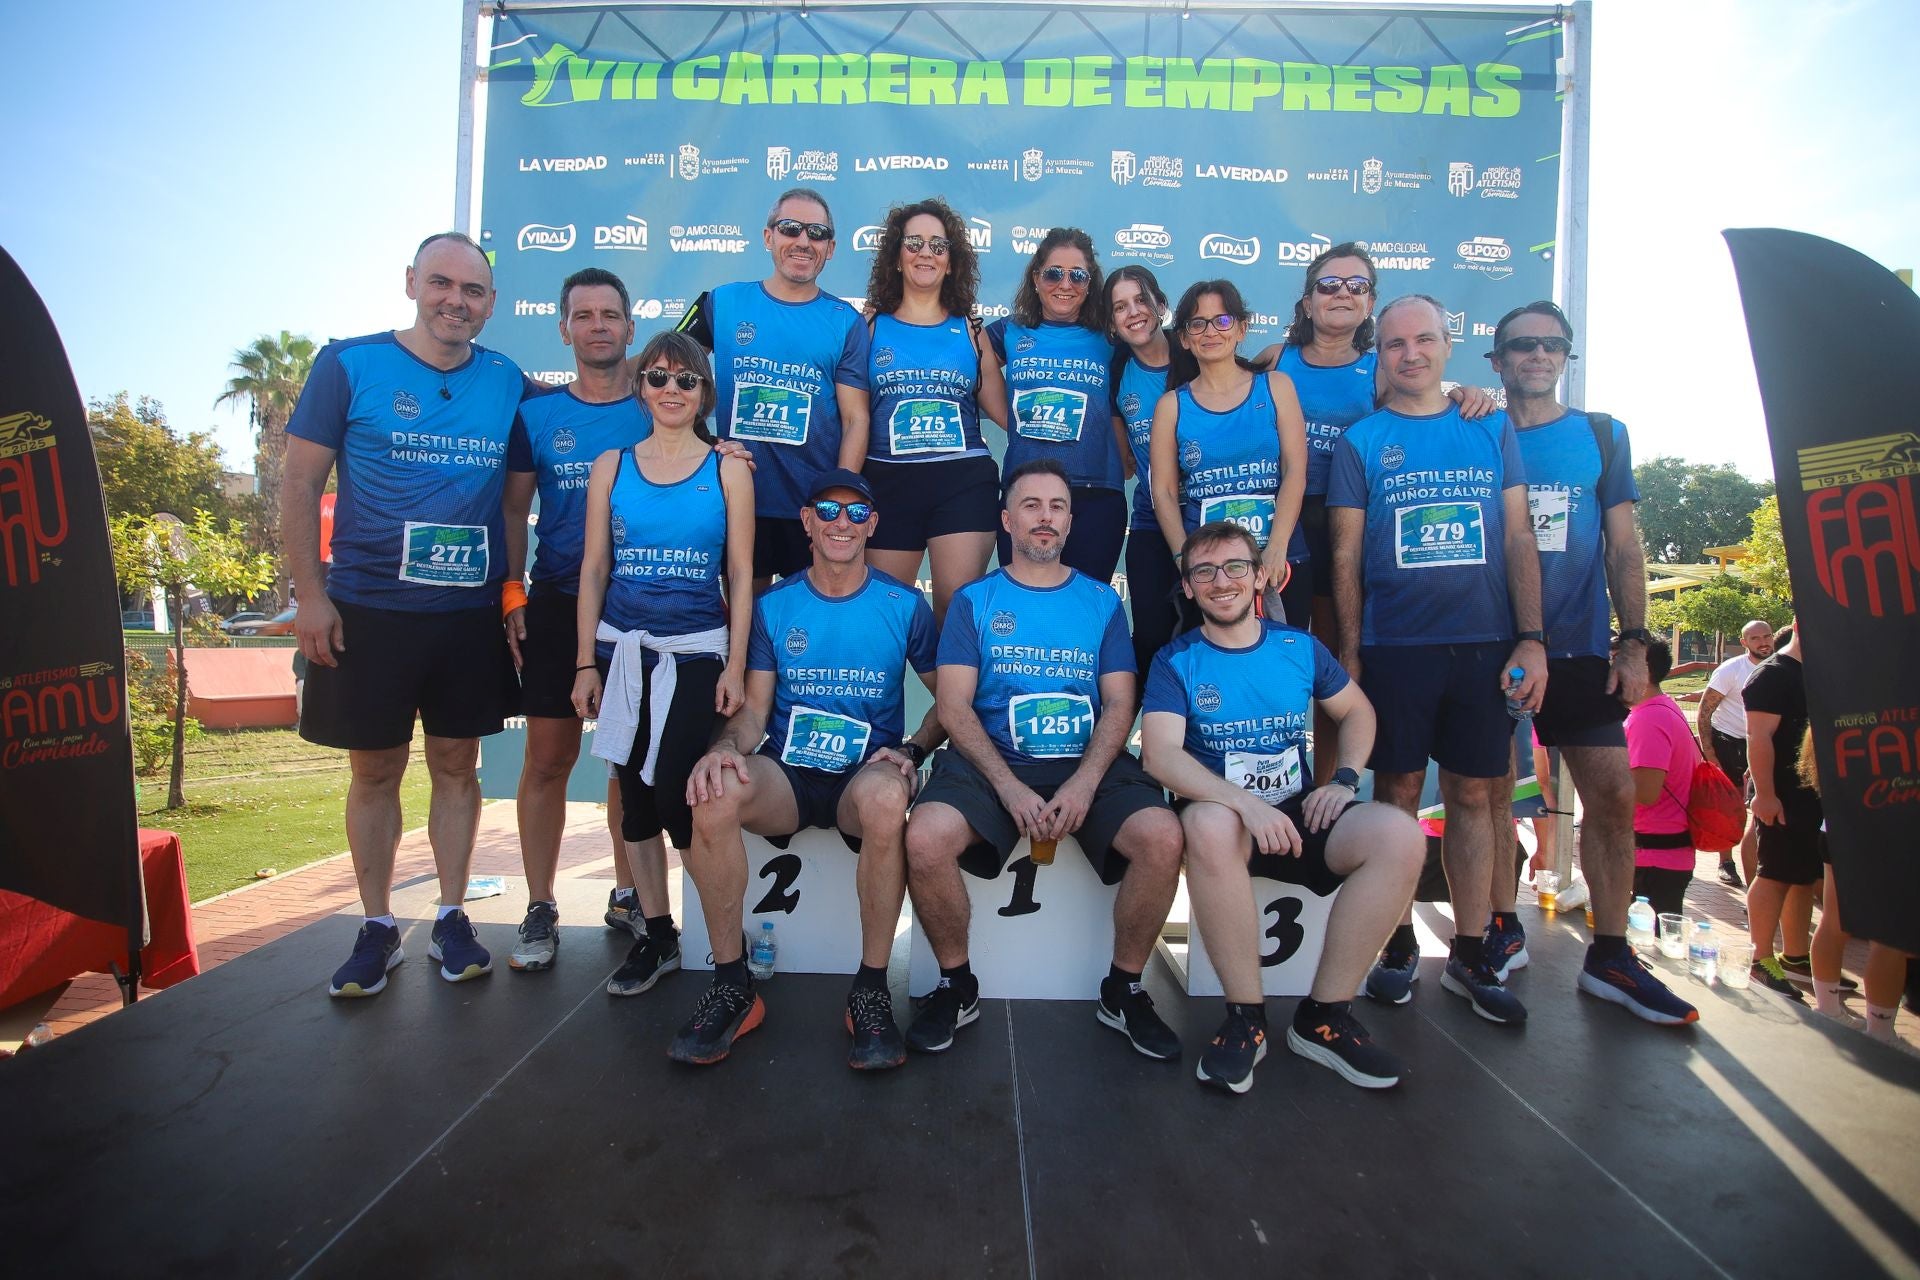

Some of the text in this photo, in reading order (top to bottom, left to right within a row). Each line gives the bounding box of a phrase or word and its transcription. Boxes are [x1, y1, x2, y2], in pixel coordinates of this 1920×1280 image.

[672, 51, 1010, 105] CARRERA
[1023, 56, 1112, 107] DE
[1124, 56, 1522, 118] EMPRESAS
[519, 155, 608, 172] LA VERDAD
[702, 158, 750, 167] Ayuntamiento
[712, 166, 738, 174] Murcia
[792, 162, 838, 172] ATLETISMO
[855, 155, 949, 172] LA VERDAD
[1046, 159, 1094, 168] Ayuntamiento
[1056, 167, 1082, 175] Murcia
[1138, 170, 1183, 178] ATLETISMO
[1195, 164, 1288, 183] LA VERDAD
[1308, 172, 1348, 181] MURCIA
[1384, 170, 1432, 180] Ayuntamiento
[1394, 180, 1420, 189] Murcia
[1476, 180, 1520, 188] ATLETISMO
[525, 230, 568, 244] VIDAL
[594, 226, 648, 245] DSM
[708, 224, 742, 236] GLOBAL
[1208, 240, 1252, 256] VIDAL
[1278, 242, 1331, 260] DSM
[1370, 242, 1428, 253] AMC GLOBAL
[1472, 323, 1498, 336] He
[733, 356, 822, 382] DESTILERÍAS
[1012, 357, 1105, 376] DESTILERÍAS
[531, 371, 577, 384] VERD
[733, 370, 822, 396] MUÑOZ GÁLVEZ
[876, 368, 971, 388] DESTILERÍAS
[1012, 368, 1104, 388] MUÑOZ GÁLVEZ
[880, 382, 967, 398] MUÑOZ GÁLVEZ
[753, 402, 789, 421] 271
[1032, 405, 1066, 422] 274
[910, 416, 946, 432] 275
[12, 439, 47, 456] 2025
[391, 431, 505, 455] DESTILERÍAS
[391, 450, 450, 465] MUÑOZ
[1384, 466, 1494, 491] DESTILERÍAS
[1818, 462, 1920, 488] 1925 202
[1189, 477, 1278, 498] MUÑOZ GÁLVEZ
[1385, 485, 1492, 504] MUÑOZ GÁLVEZ
[1420, 522, 1465, 542] 279
[430, 544, 472, 562] 277
[616, 548, 709, 564] DESTILERÍAS
[656, 564, 706, 580] GÁLVEZ
[990, 646, 1094, 666] DESTILERÍAS
[13, 666, 78, 688] ATLETISMO
[786, 667, 886, 684] DESTILERÍAS
[992, 660, 1094, 682] MUÑOZ GÁLVEZ
[790, 684, 884, 699] MUÑOZ GÁLVEZ
[0, 676, 120, 738] AMU
[1028, 716, 1080, 735] 1251
[1200, 711, 1306, 737] DESTILERÍAS
[1834, 714, 1878, 728] murcia
[806, 730, 846, 753] 270
[1204, 730, 1306, 752] MUÑOZ GÁLVEZ
[3, 732, 111, 769] Corriendo
[1243, 770, 1290, 790] 2041
[752, 854, 802, 914] 2
[997, 854, 1042, 918] 1
[1261, 896, 1305, 968] 3
